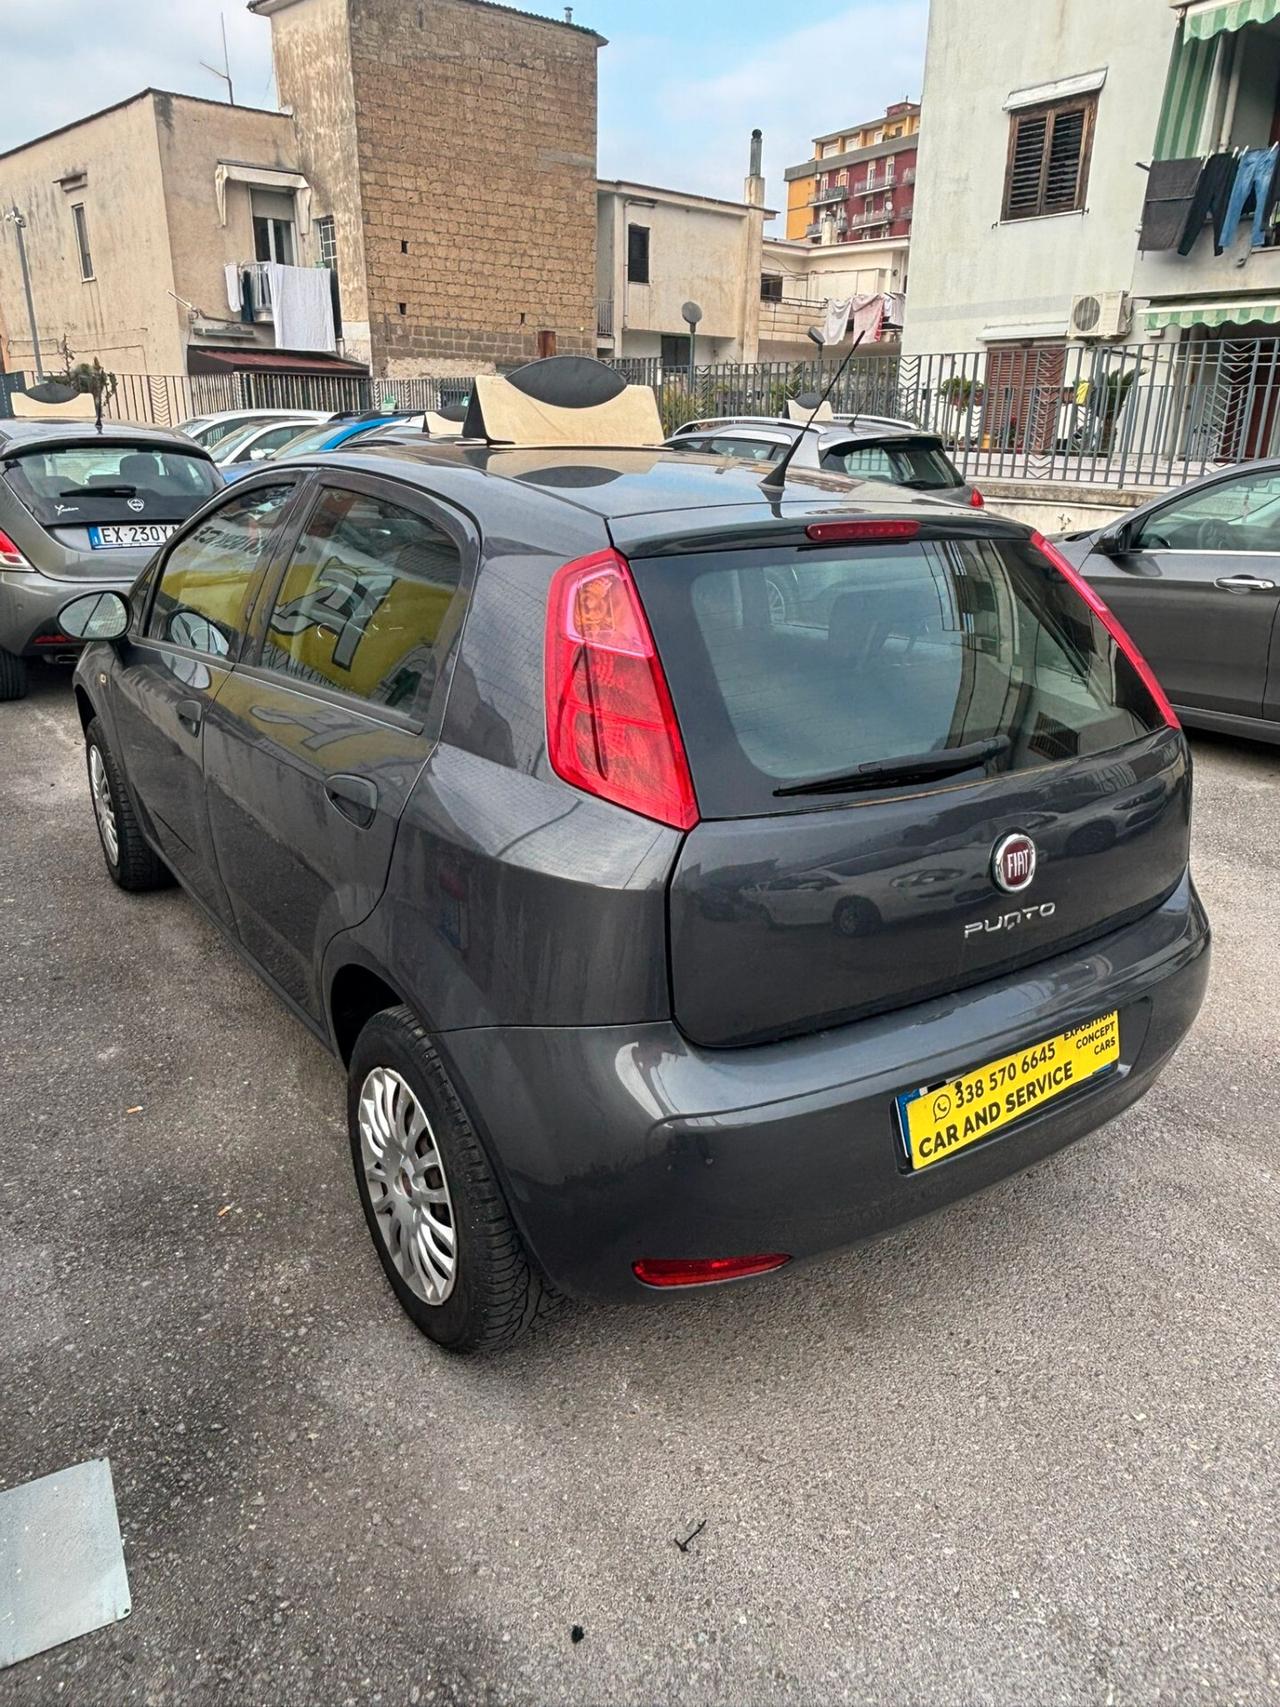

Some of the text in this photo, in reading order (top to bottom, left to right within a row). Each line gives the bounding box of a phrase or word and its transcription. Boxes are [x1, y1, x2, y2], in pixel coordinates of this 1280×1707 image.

[101, 526, 124, 544] EX
[1007, 850, 1029, 878] FIAT
[964, 902, 1056, 939] PUNTO
[1075, 1020, 1115, 1050] CONCEPT
[1093, 1036, 1116, 1056] CARS
[955, 1042, 1056, 1108] 338 570 6645
[918, 1060, 1073, 1158] CAR AND SERVICE
